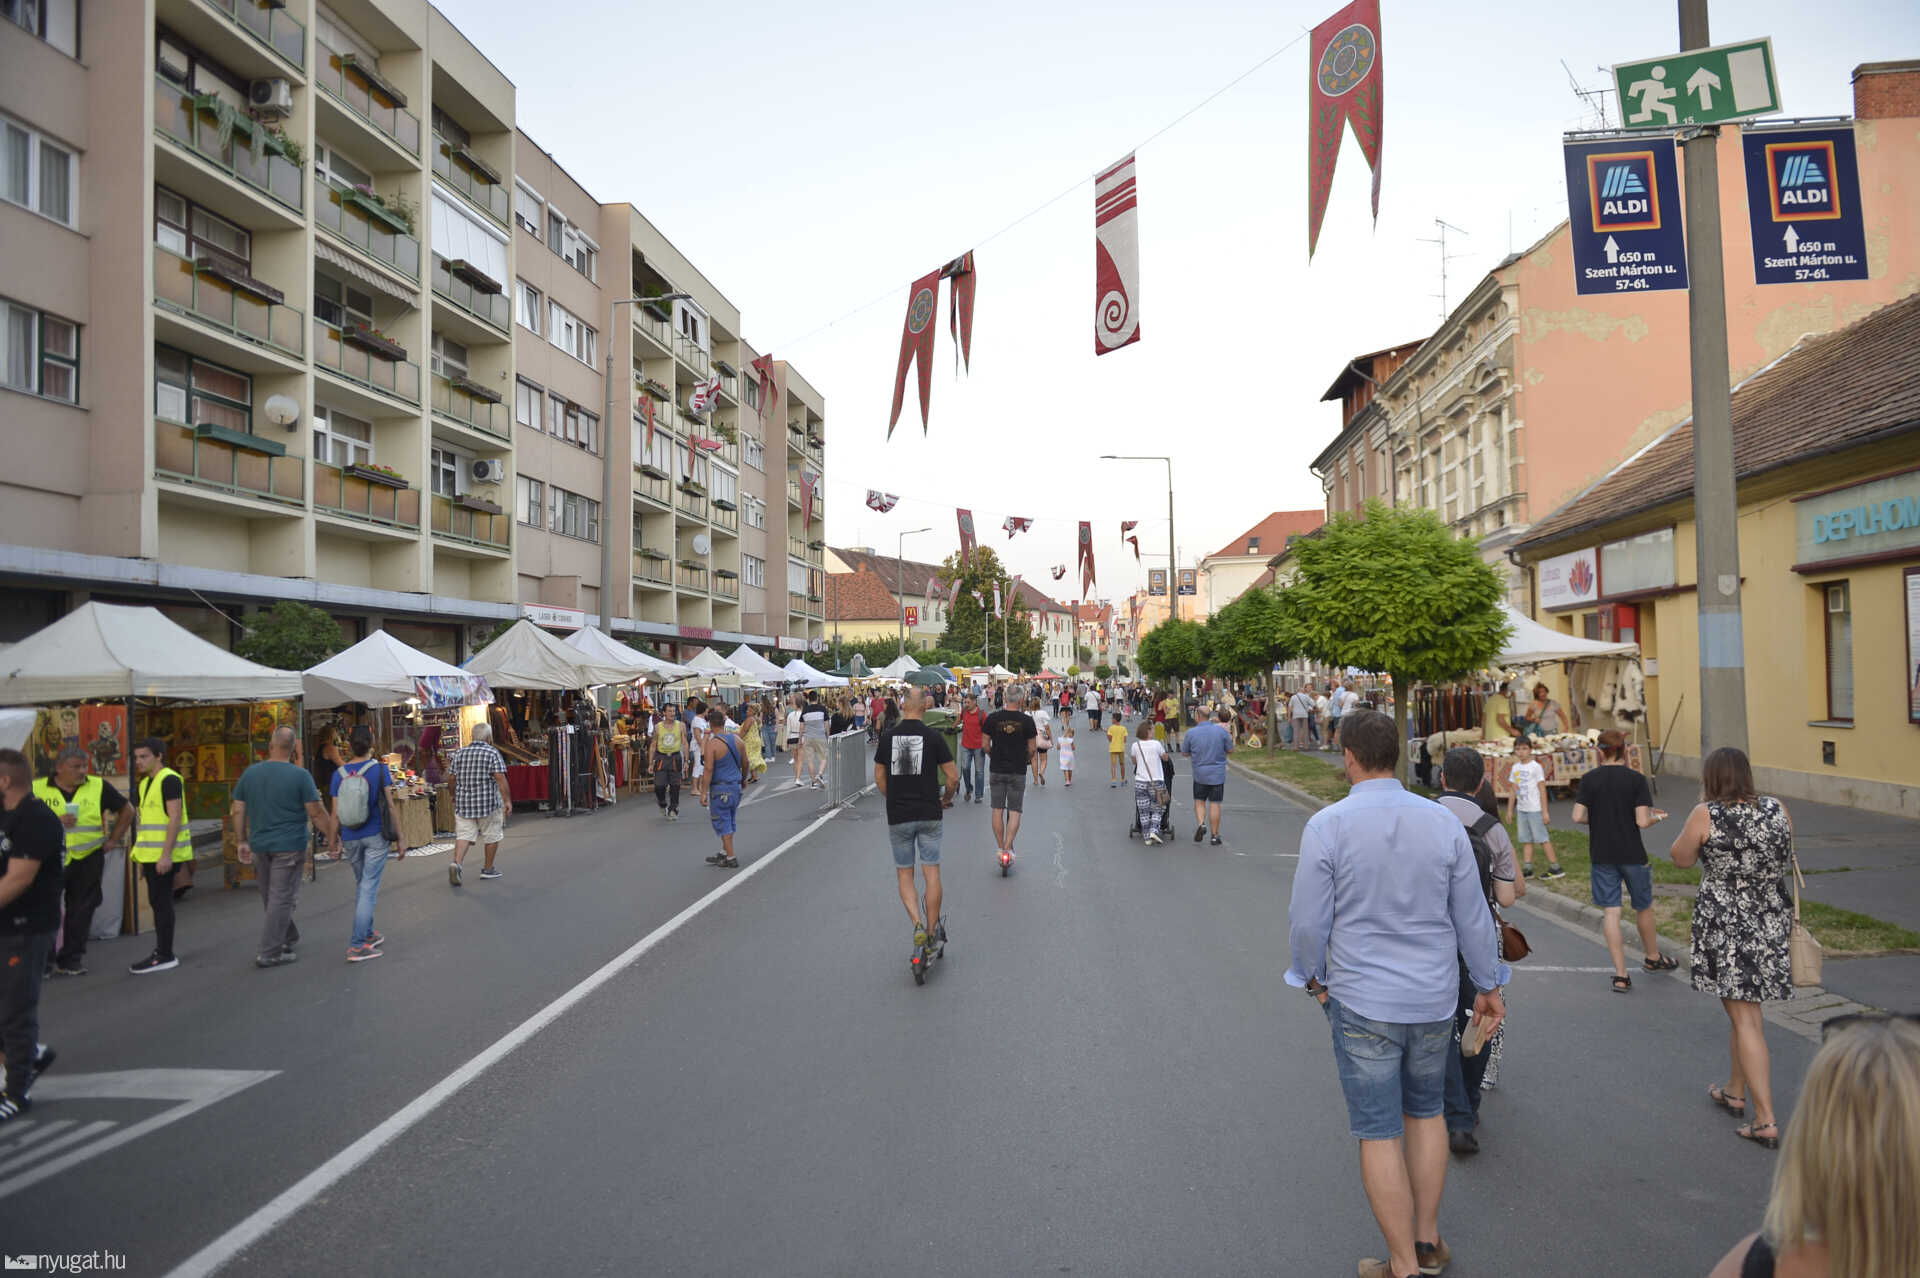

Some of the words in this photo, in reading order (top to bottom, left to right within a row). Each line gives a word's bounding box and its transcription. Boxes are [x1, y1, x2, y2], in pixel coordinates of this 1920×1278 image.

[1782, 189, 1828, 205] ALDI
[1603, 199, 1648, 215] ALDI
[1799, 242, 1821, 252] 650
[1824, 241, 1836, 251] m
[1619, 252, 1641, 263] 650
[1643, 252, 1656, 261] m
[1764, 256, 1797, 268] Szent
[1799, 254, 1843, 266] Márton
[1845, 255, 1857, 264] u.
[1585, 267, 1618, 278] Szent
[1620, 264, 1662, 276] Márton
[1664, 265, 1677, 273] u.
[1795, 269, 1830, 280] 57-61.
[1615, 279, 1650, 290] 57-61.
